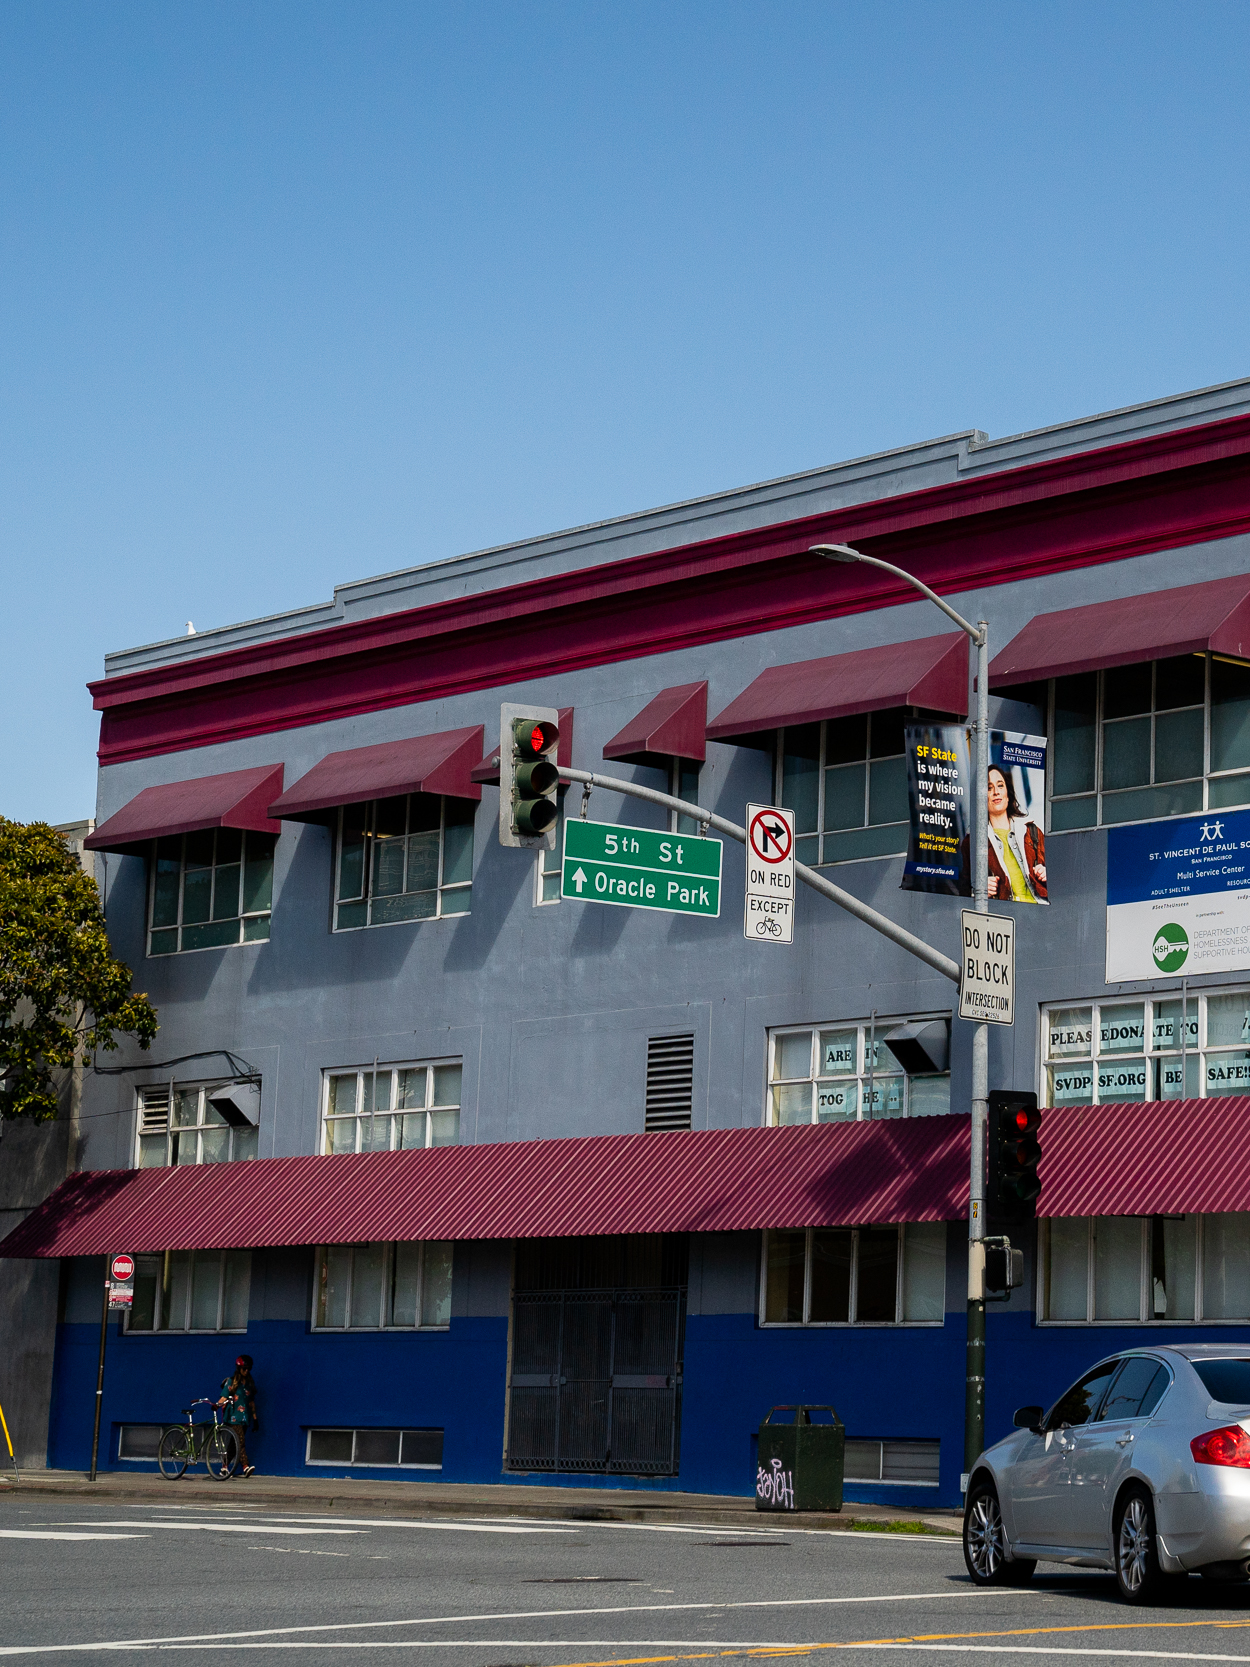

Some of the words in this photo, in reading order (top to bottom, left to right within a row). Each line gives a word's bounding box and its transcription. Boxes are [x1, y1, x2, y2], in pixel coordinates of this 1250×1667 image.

[917, 745, 929, 757] SF
[931, 747, 957, 762] State
[1003, 754, 1016, 762] STATE
[1016, 756, 1041, 766] UNIVERSITY
[1014, 747, 1043, 758] FRANCISCO
[917, 761, 927, 773] is
[928, 763, 958, 779] where
[918, 780, 933, 792] my
[936, 781, 964, 796] vision
[919, 794, 956, 811] became
[919, 813, 953, 830] reality.
[605, 834, 639, 855] 5th
[659, 843, 683, 864] St
[1149, 853, 1162, 861] ST.
[1164, 847, 1200, 859] VINCENT
[1202, 846, 1214, 855] DE
[1216, 842, 1238, 853] PAUL
[1203, 855, 1233, 863] FRANCISCO
[750, 869, 765, 885] ON
[770, 872, 791, 889] RED
[1177, 871, 1194, 880] Multi
[1195, 868, 1220, 878] Service
[1221, 865, 1245, 875] Center
[595, 872, 656, 899] Oracle
[667, 881, 710, 906] Park
[1169, 886, 1191, 894] SHELTER
[751, 899, 789, 915] EXCEPT
[1152, 902, 1189, 911] #SeeTheUnseen
[1193, 927, 1239, 939] DEPARTMENT
[1240, 925, 1250, 934] OF
[965, 927, 980, 949] DO
[987, 931, 1010, 955] NOT
[1154, 945, 1169, 953] HSH
[1193, 936, 1248, 949] HOMELESSNESS
[1193, 947, 1235, 959] SUPPORTIVE
[967, 958, 1009, 986] BLOCK
[965, 991, 1009, 1011] INTERSECTION
[826, 1050, 852, 1063] ARE
[1165, 1070, 1183, 1084] BE
